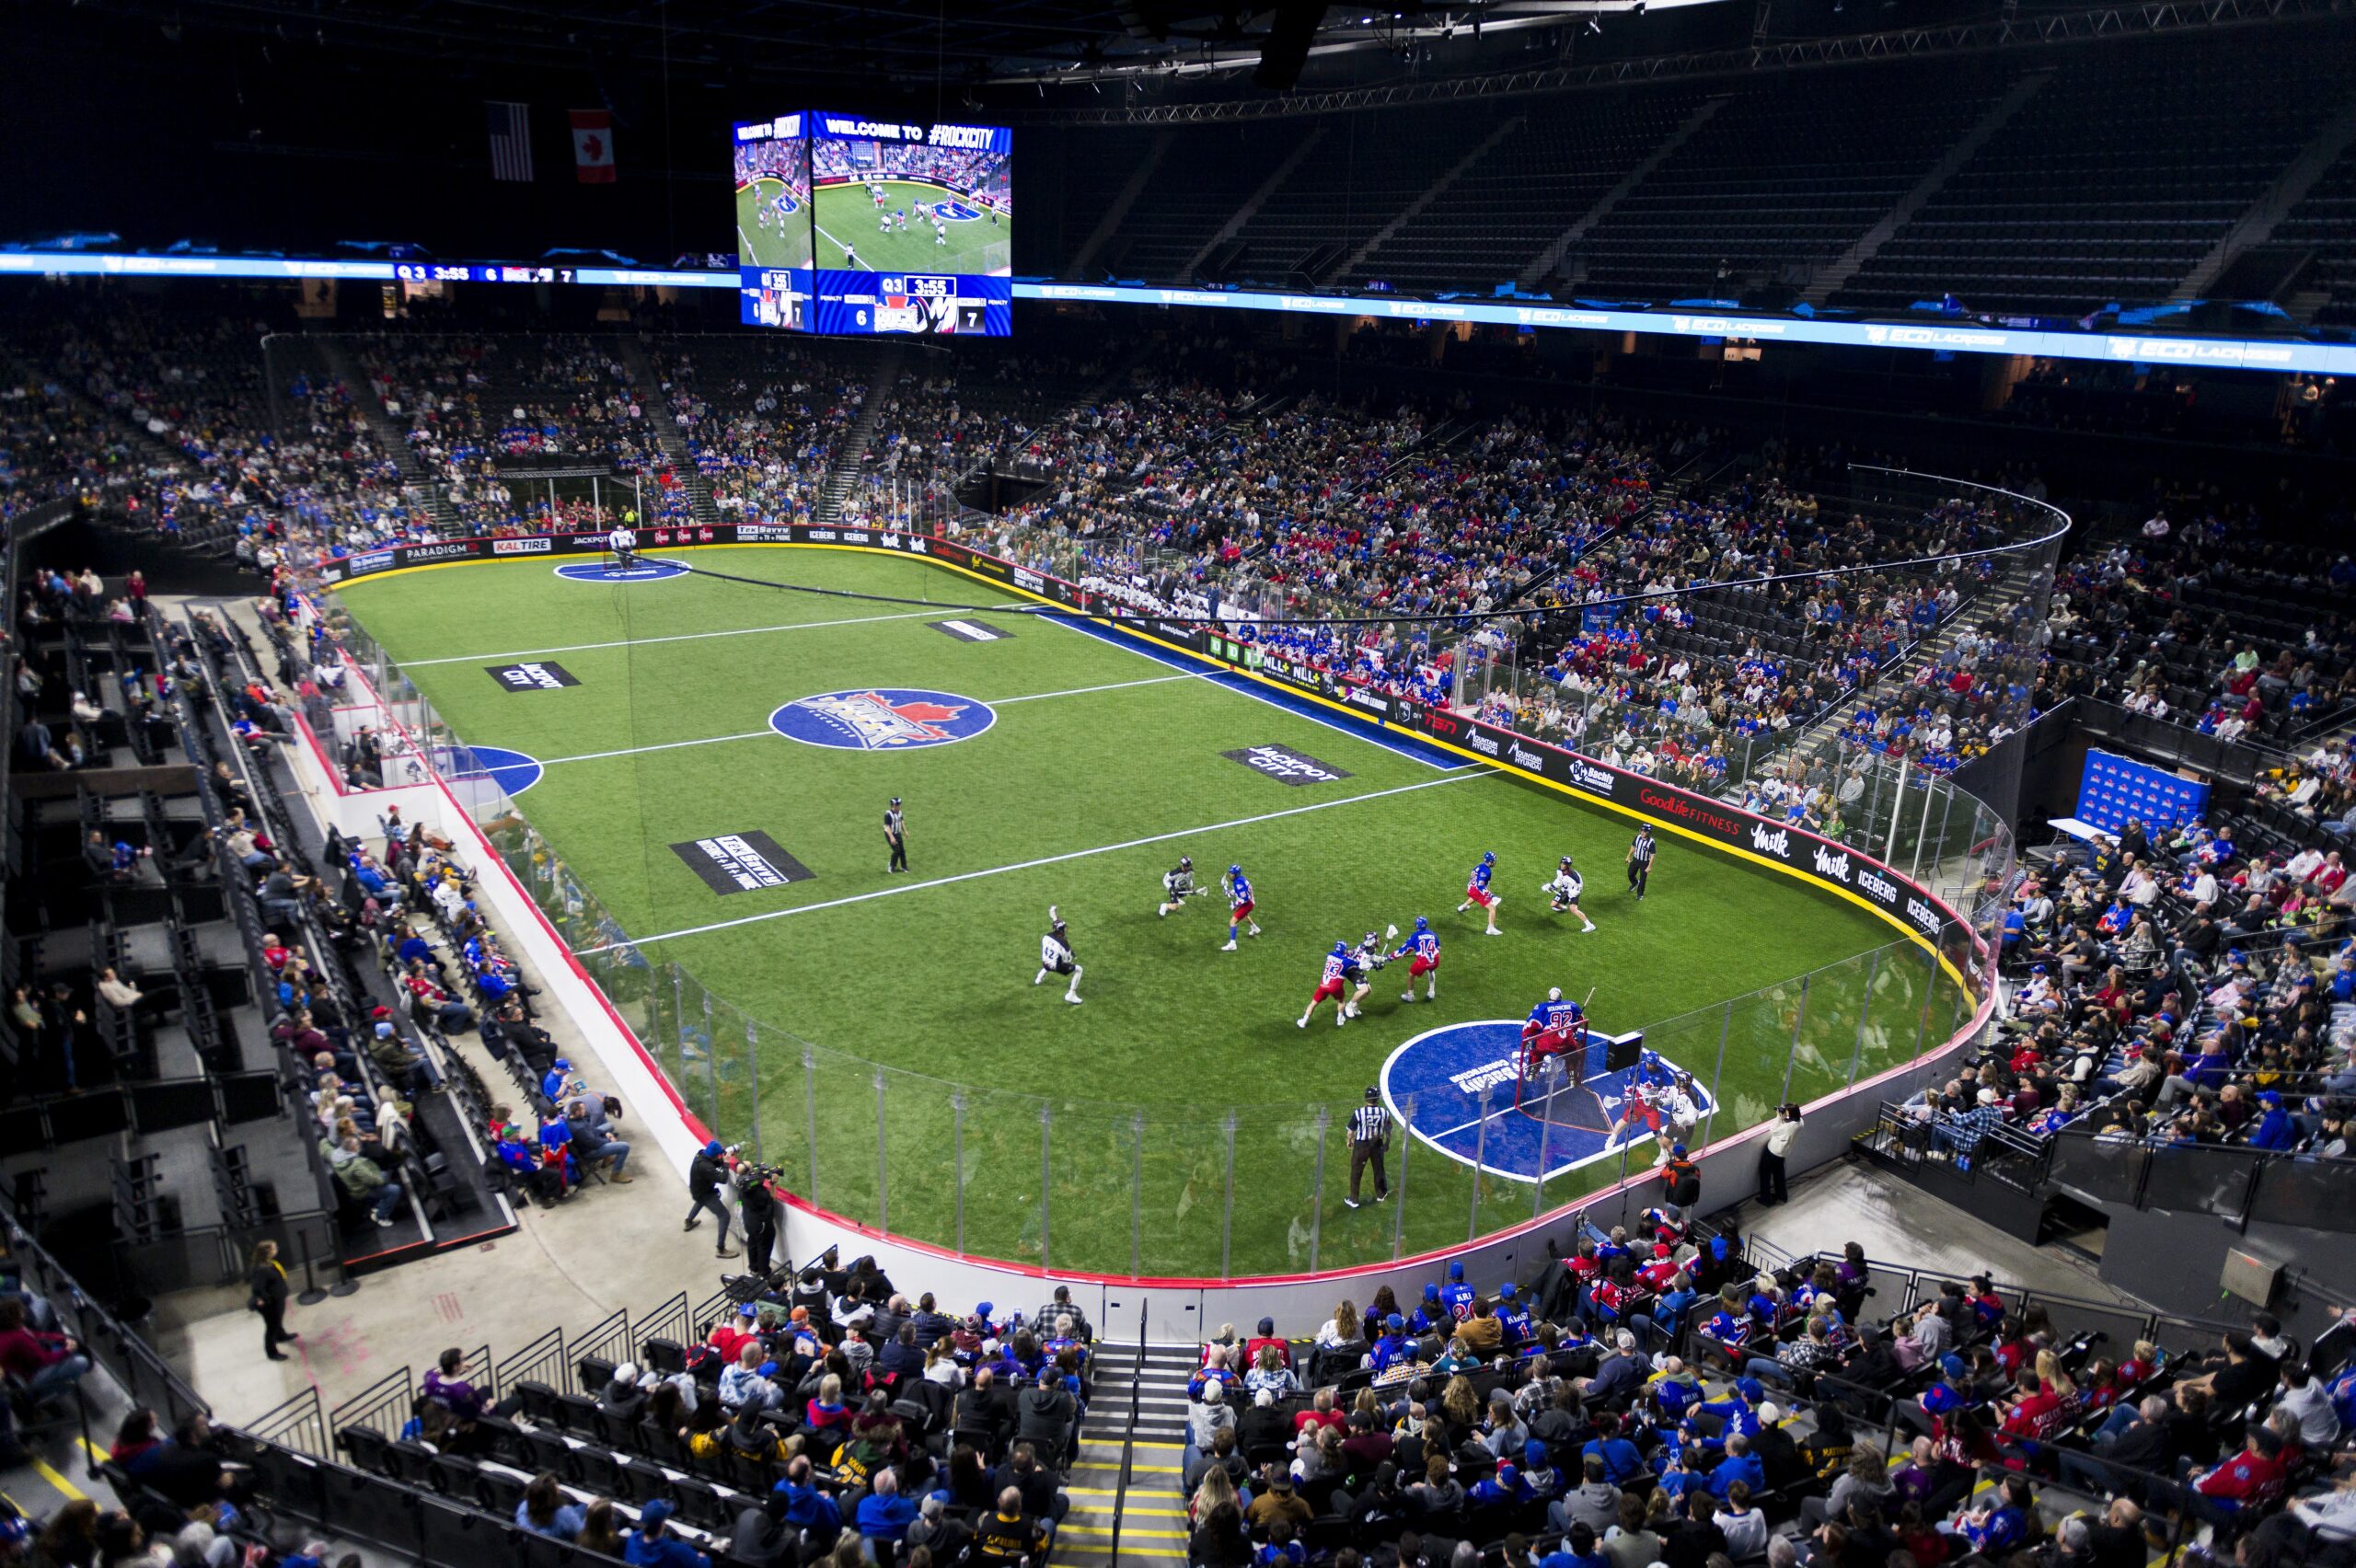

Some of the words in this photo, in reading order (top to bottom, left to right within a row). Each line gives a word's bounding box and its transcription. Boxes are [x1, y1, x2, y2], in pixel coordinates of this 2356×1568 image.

[826, 119, 900, 139] WELCOME
[902, 125, 923, 141] TO
[929, 124, 994, 149] #ROCKCITY
[433, 266, 470, 281] 3:55
[485, 268, 497, 281] 6
[560, 270, 572, 282] 7
[882, 278, 903, 293] Q3
[915, 279, 946, 294] 3:55
[856, 310, 867, 326] 6
[967, 313, 977, 327] 7
[572, 536, 608, 545] JACKPOT
[809, 531, 837, 540] ICEBERG
[843, 532, 869, 543] ICEBERG
[406, 544, 468, 559] PARADIGM
[496, 540, 519, 551] KAL
[520, 538, 549, 550] TIRE
[502, 670, 534, 685] CITY
[518, 663, 565, 688] JACKPOT
[1425, 712, 1457, 734] TSN
[1465, 723, 1498, 747] MOUNTAIN
[1472, 741, 1498, 755] HYUNDAI
[1507, 738, 1542, 764] MOUNTAIN
[1248, 756, 1299, 776] CITY
[1249, 746, 1339, 780] JACKPOT
[1515, 756, 1542, 772] HYUNDAI
[1584, 776, 1613, 790] Construction
[1588, 767, 1615, 784] Bachly
[1640, 789, 1690, 817] GoodLife
[1690, 807, 1739, 836] FITNESS
[1750, 822, 1790, 859] Milk
[1813, 845, 1851, 883] Milk
[1858, 870, 1897, 903] ICEBERG
[1907, 897, 1940, 934] ICEBERG
[1419, 940, 1436, 957] 14
[1550, 1011, 1573, 1030] 92
[1366, 1114, 1380, 1126] 27
